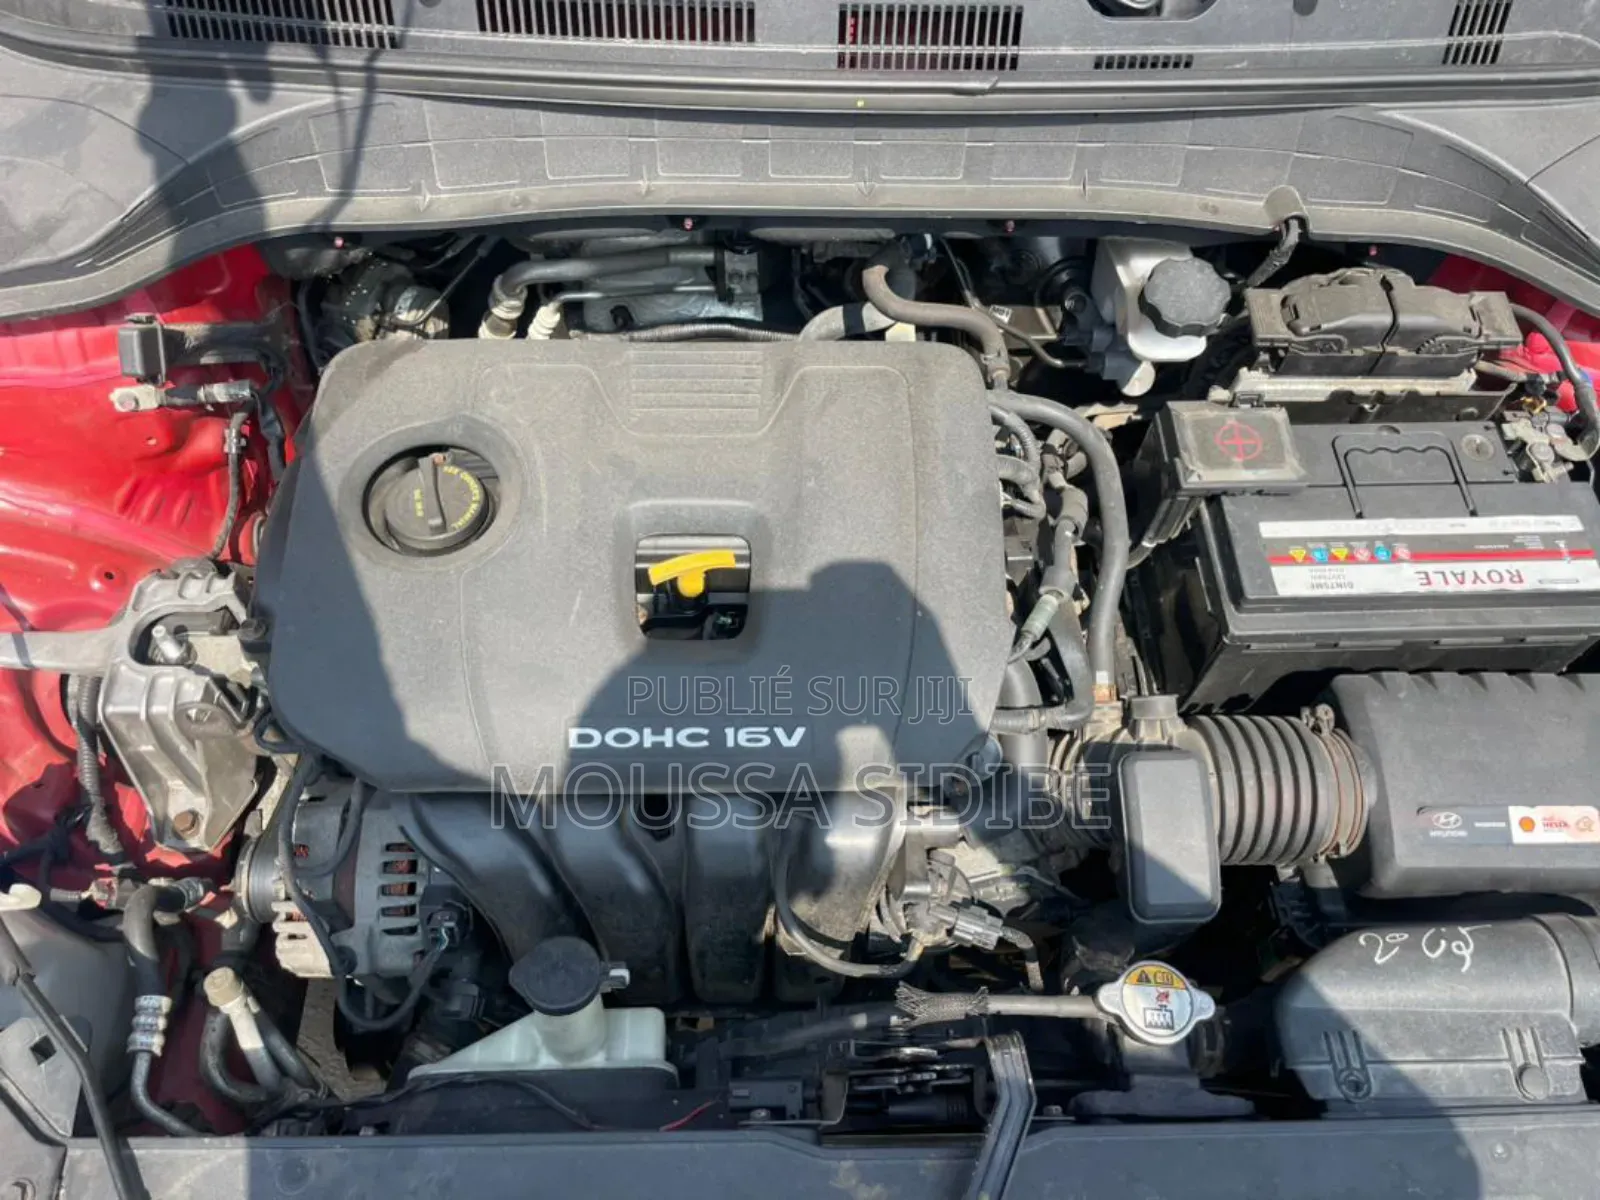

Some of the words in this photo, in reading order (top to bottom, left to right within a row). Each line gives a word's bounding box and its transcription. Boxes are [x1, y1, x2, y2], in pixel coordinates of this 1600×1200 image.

[1415, 568, 1524, 587] ROYALE
[568, 726, 710, 749] DOHC
[725, 725, 806, 748] 16V
